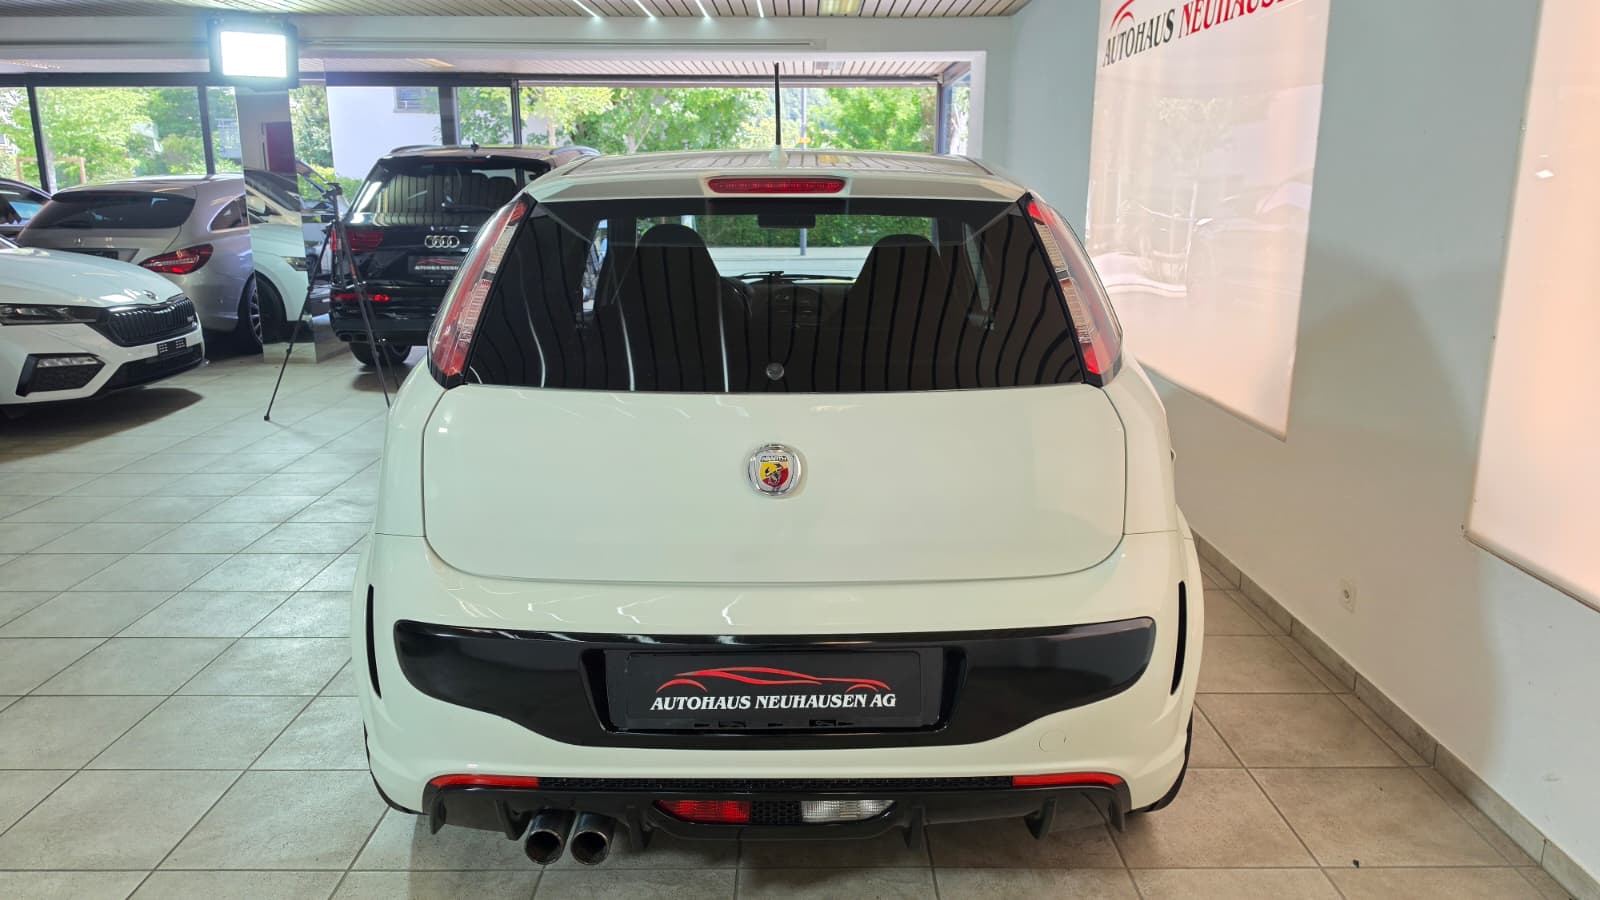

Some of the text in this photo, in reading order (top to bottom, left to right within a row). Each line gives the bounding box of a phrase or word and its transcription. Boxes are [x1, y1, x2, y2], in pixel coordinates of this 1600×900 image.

[1102, 9, 1175, 67] AUTOHAUS
[650, 694, 896, 710] AUTOHAUS NEUHAUSEN AG
